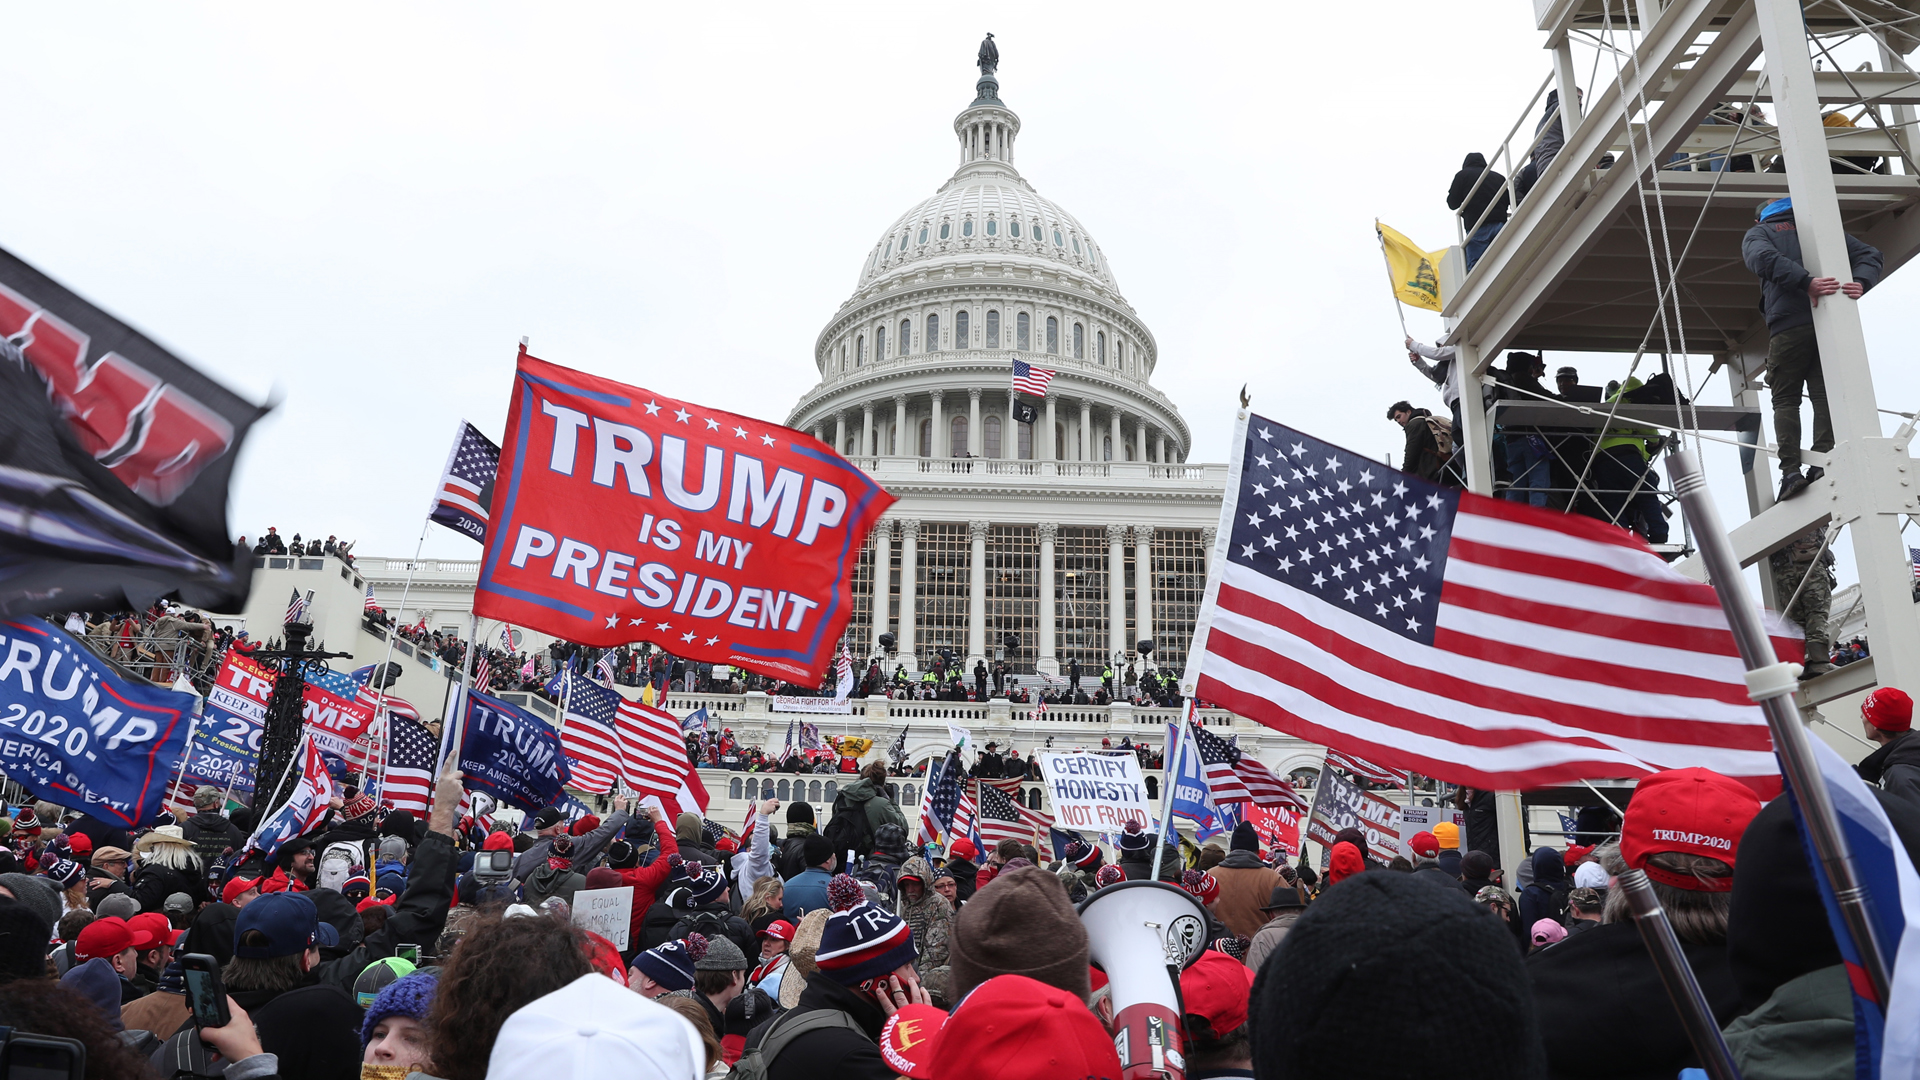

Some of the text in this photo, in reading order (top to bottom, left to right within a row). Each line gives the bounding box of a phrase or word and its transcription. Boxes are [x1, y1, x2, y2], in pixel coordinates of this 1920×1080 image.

[541, 397, 847, 546] TRUMP
[456, 516, 484, 536] 2020
[637, 513, 753, 570] IS MY
[510, 525, 818, 632] PRESIDENT
[0, 634, 158, 750] RUMP
[214, 690, 249, 711] KEEP
[775, 695, 800, 705] GEORGIA
[800, 697, 817, 705] FIGHT
[817, 698, 829, 706] FOR
[320, 697, 359, 716] Donald
[195, 729, 208, 739] For
[211, 736, 249, 756] President
[190, 763, 223, 780] YOUR
[460, 759, 486, 773] KEEP
[1053, 756, 1127, 779] CERTIFY
[1054, 778, 1140, 802] HONESTY
[1175, 784, 1203, 804] KEEP
[1330, 774, 1401, 828] TRUMP
[1061, 804, 1148, 829] NOT FRAUD
[1651, 829, 1732, 851] TRUMP2020
[591, 897, 620, 910] EQUAL
[591, 912, 622, 926] MORAL
[880, 1037, 917, 1073] PRESIDENT
